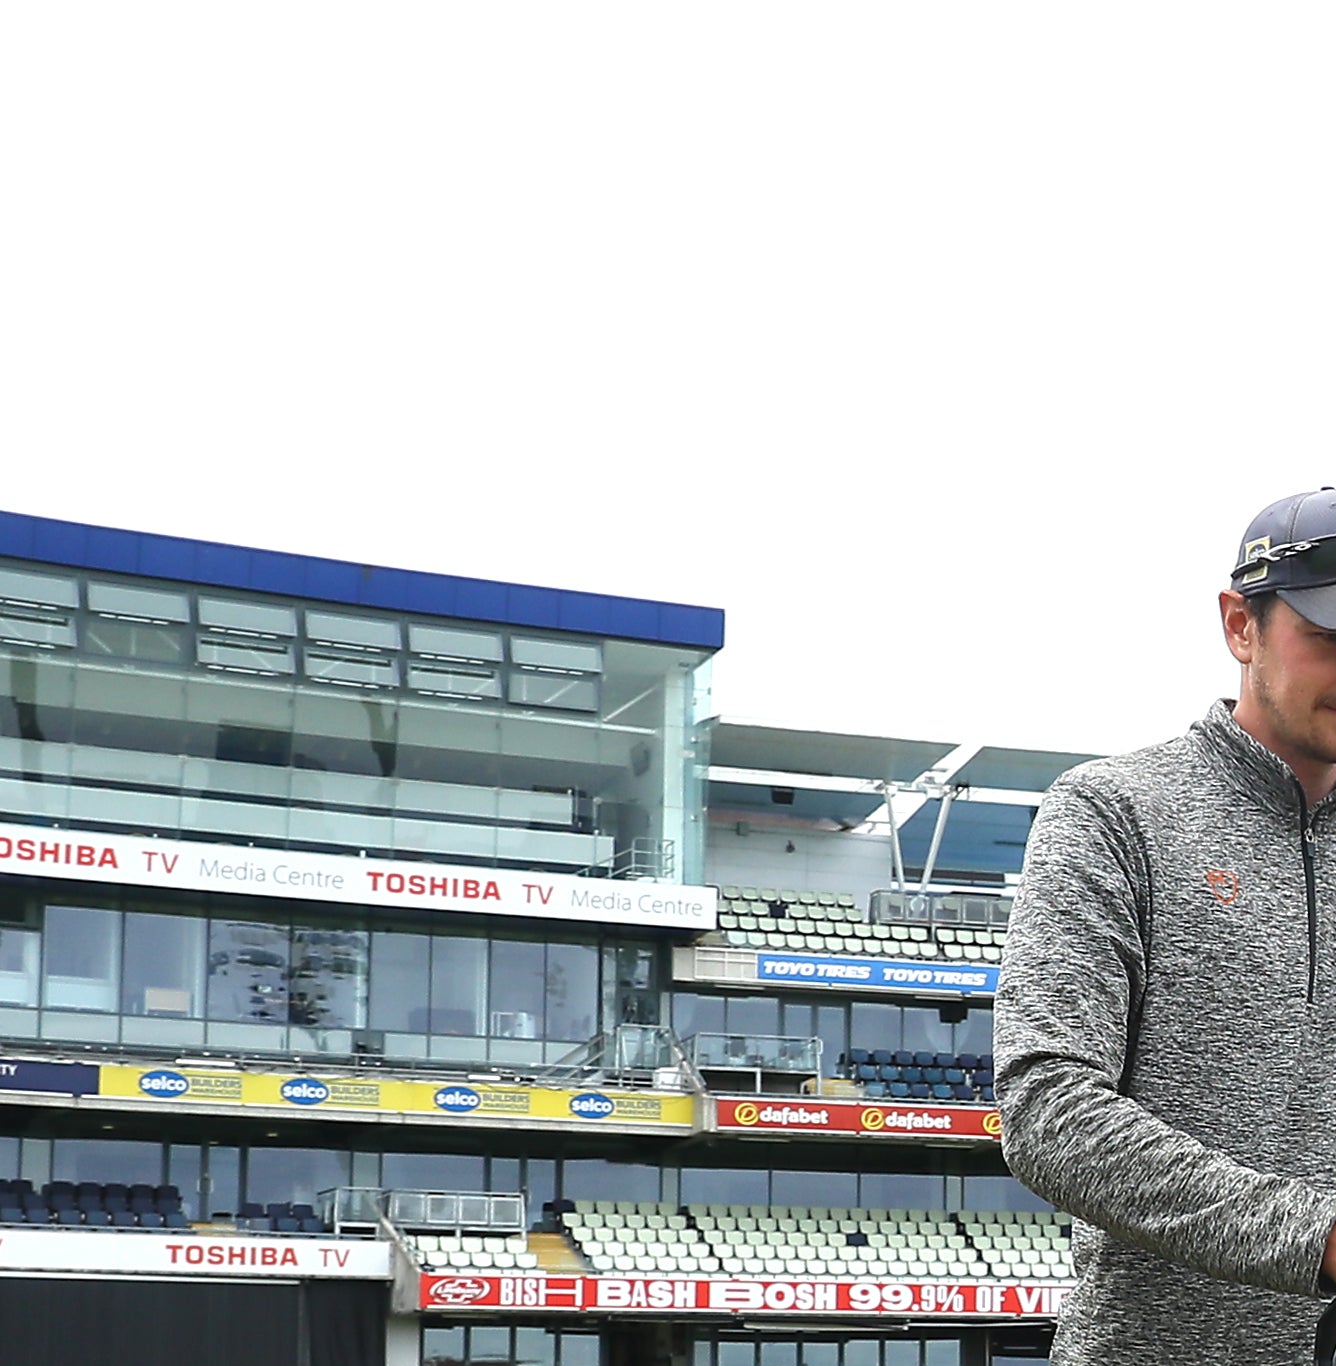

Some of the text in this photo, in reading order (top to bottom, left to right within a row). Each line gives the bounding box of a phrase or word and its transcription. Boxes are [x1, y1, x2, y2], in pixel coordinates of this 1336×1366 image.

[142, 851, 179, 874] TV
[199, 858, 267, 882] Media
[273, 865, 345, 889] Centre
[367, 871, 704, 917] TOSHIBA TV Media Centre
[763, 960, 871, 979] TOYO TIRES
[882, 967, 987, 986] TOYO TIRES
[141, 1075, 187, 1091] selco
[283, 1082, 327, 1100] selco
[435, 1091, 479, 1107] selco
[571, 1098, 612, 1114] selco
[760, 1106, 829, 1125] dafabet
[886, 1111, 952, 1130] dafabet
[165, 1244, 351, 1268] TOSHIBA TV
[500, 1276, 583, 1306] BISH
[597, 1279, 696, 1308] BASH
[709, 1280, 836, 1310] BOSH
[849, 1283, 964, 1312] 99.9%
[976, 1286, 1006, 1312] OF
